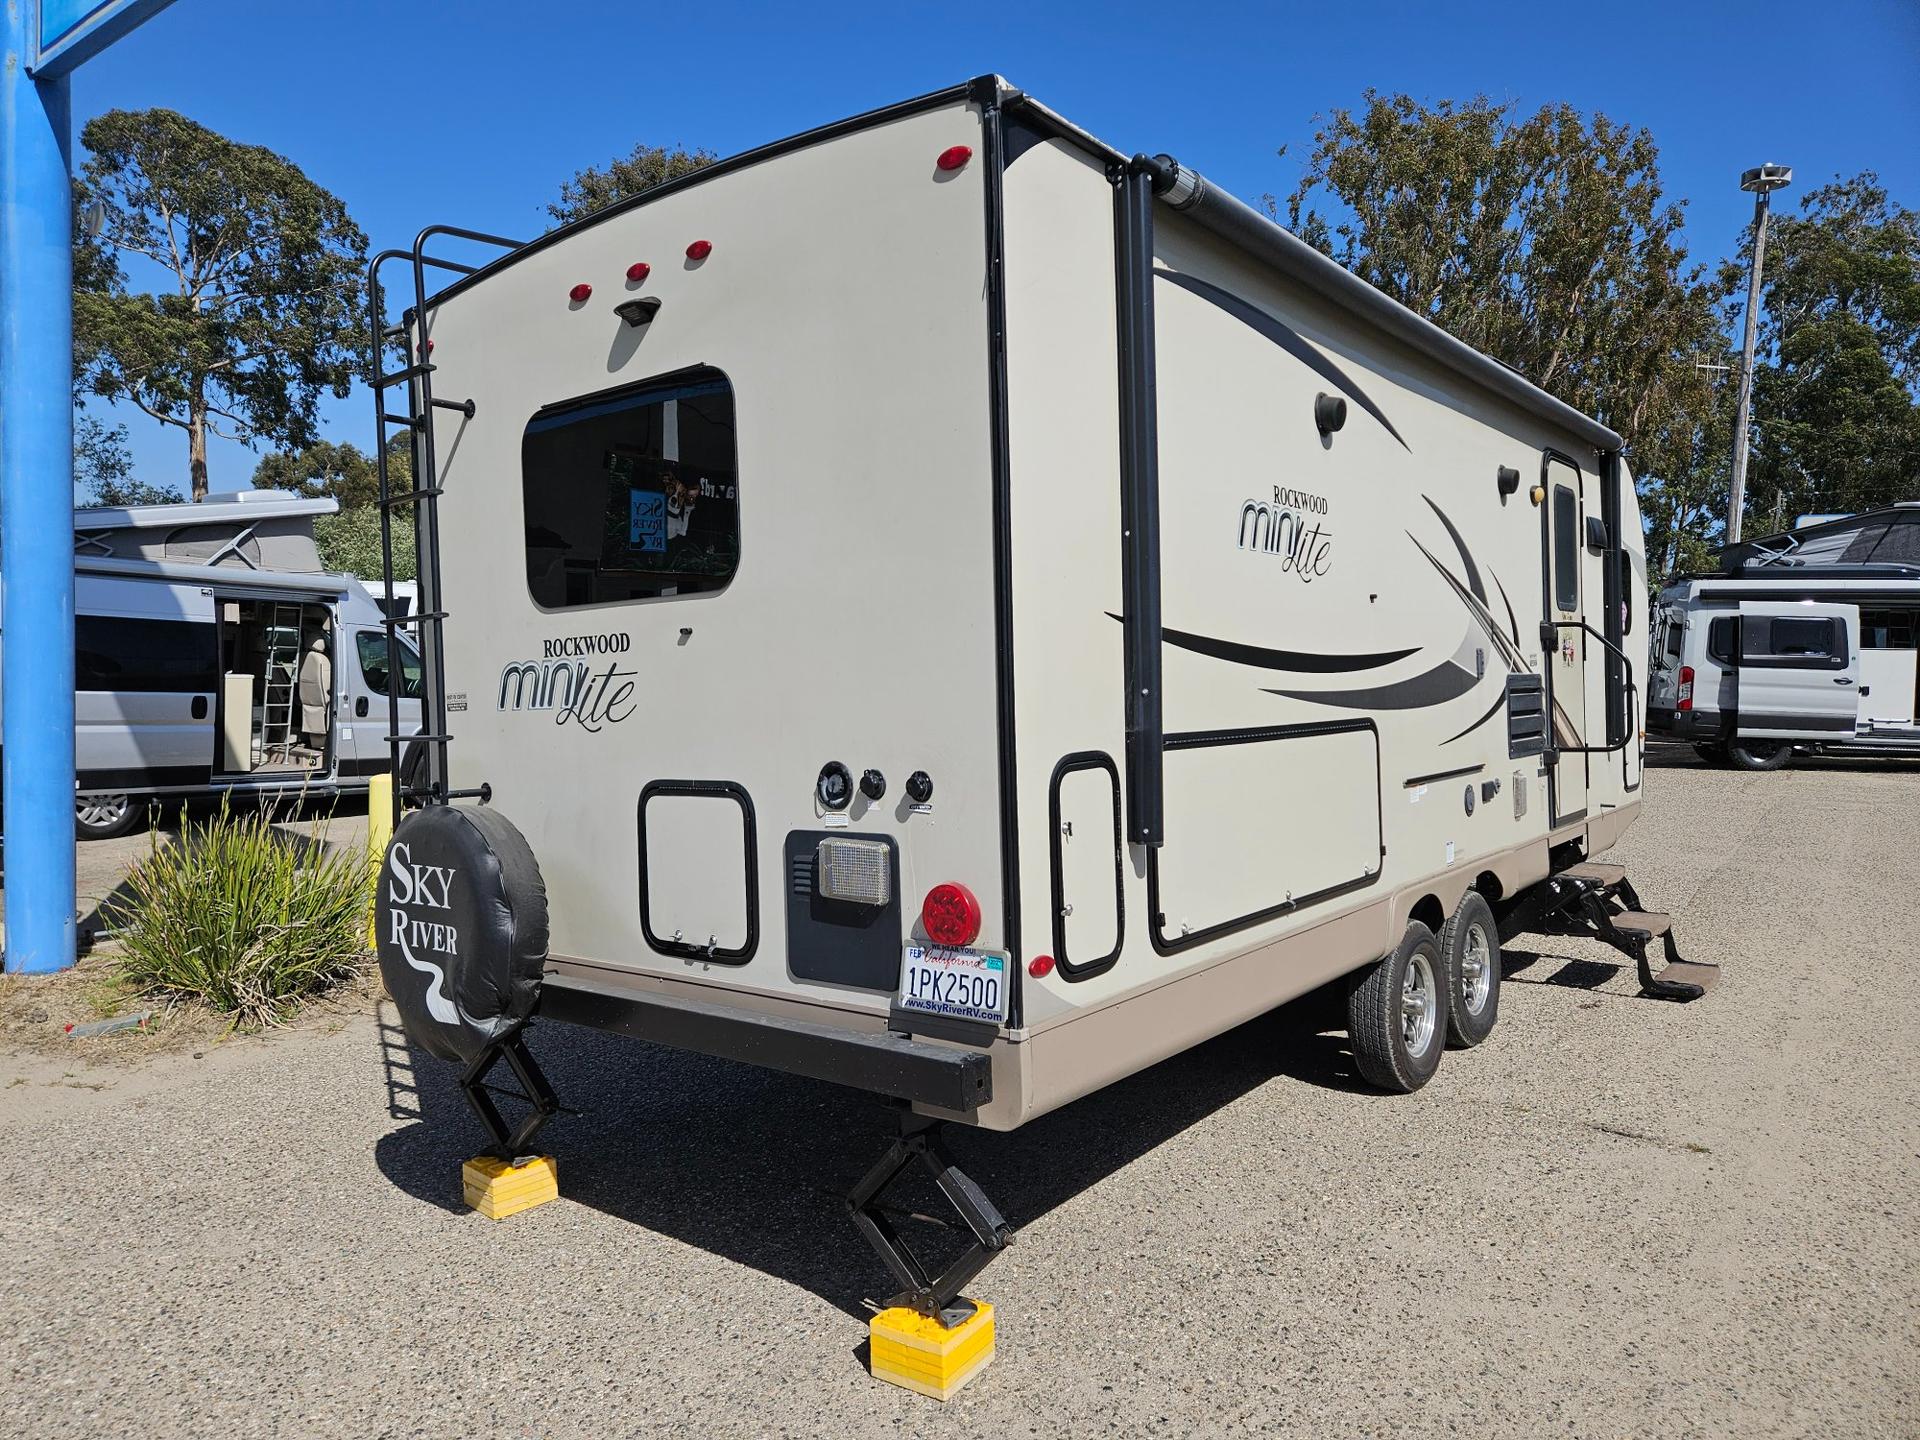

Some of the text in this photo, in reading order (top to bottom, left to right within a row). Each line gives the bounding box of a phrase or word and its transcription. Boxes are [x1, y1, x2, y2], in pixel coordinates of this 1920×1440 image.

[1273, 485, 1328, 515] ROCKWOOD
[543, 633, 630, 658] ROCKWOOD
[390, 842, 456, 909] SKY
[389, 908, 458, 955] RIVER
[909, 948, 922, 958] FEB
[924, 948, 983, 970] California
[909, 967, 998, 1009] 1PK2500
